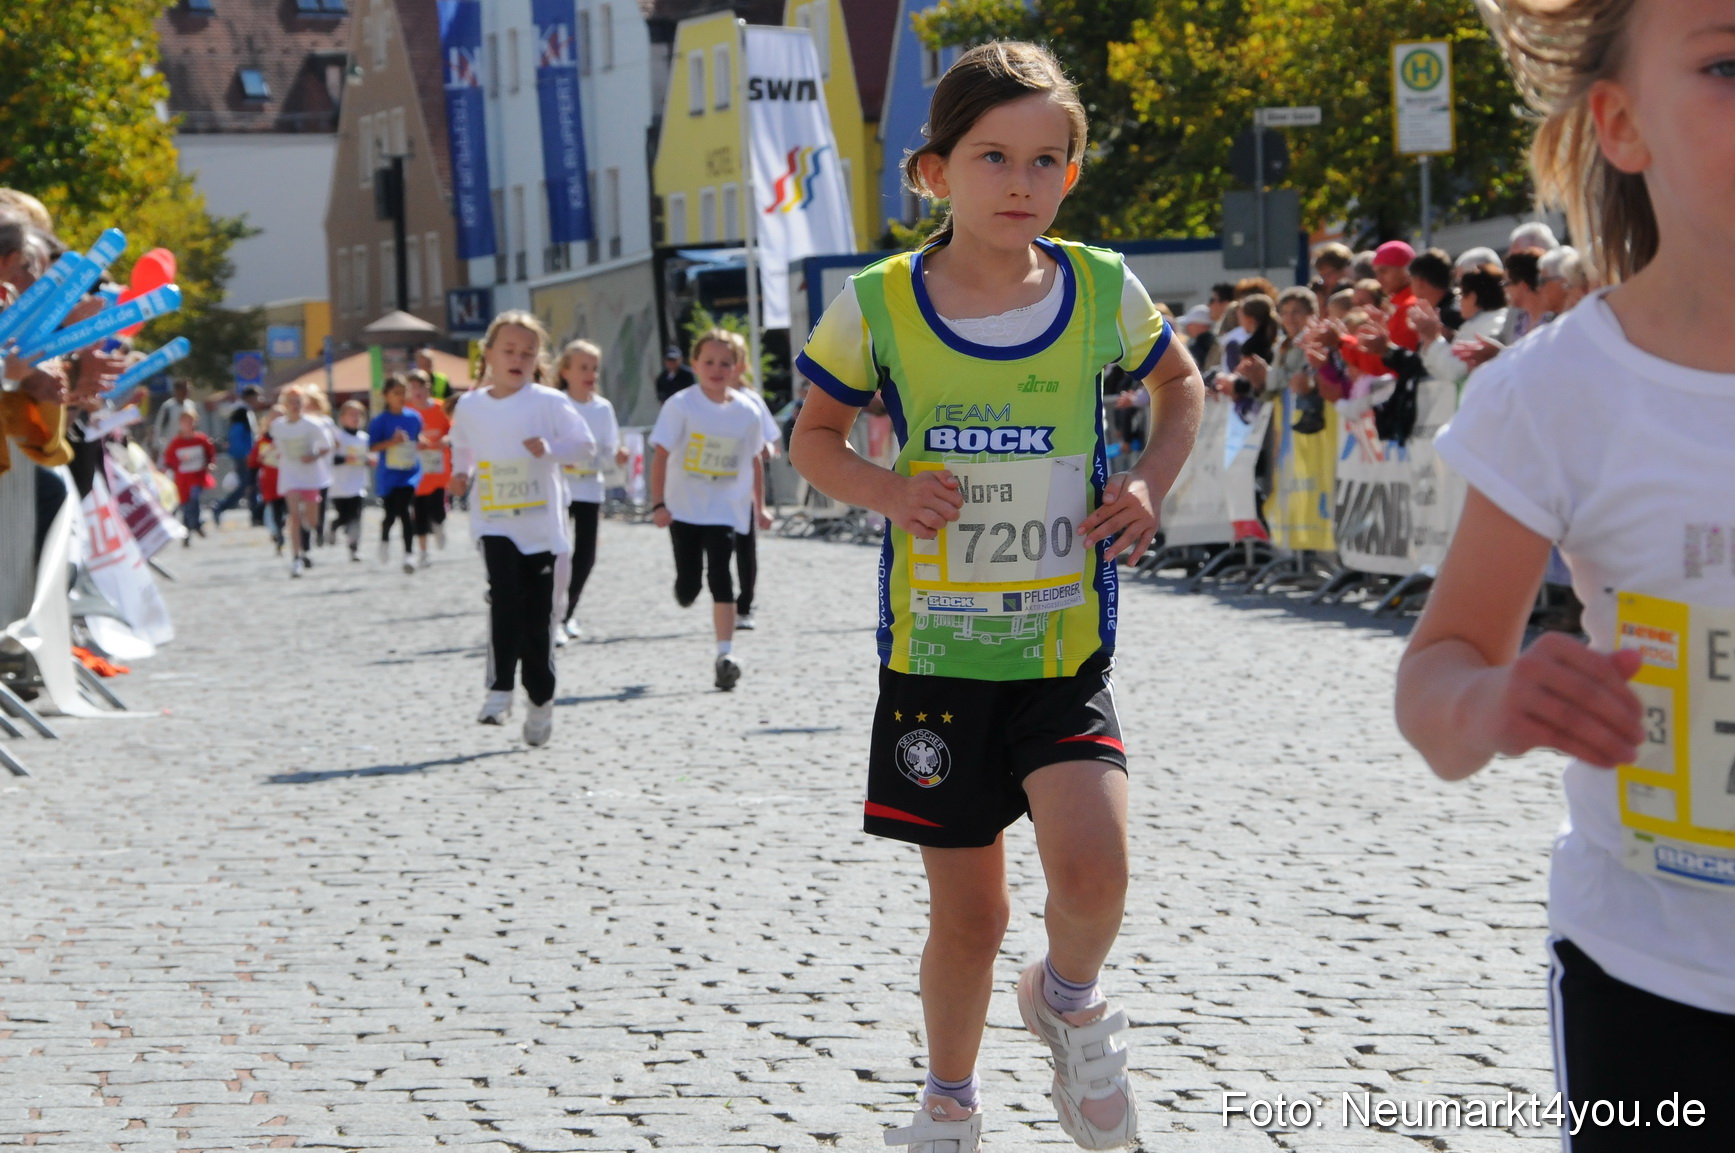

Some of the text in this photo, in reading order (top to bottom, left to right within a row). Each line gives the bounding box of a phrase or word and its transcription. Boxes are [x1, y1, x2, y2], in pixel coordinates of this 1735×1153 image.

[1411, 60, 1431, 81] H
[748, 78, 817, 101] swn
[935, 403, 1011, 422] TEAM
[924, 425, 1056, 454] BOCK
[495, 480, 540, 498] 7201
[953, 475, 1013, 503] Nora
[958, 516, 1073, 563] 7200
[928, 596, 974, 607] BOCK
[1024, 583, 1080, 603] PFLEIDERER
[899, 730, 944, 751] DEUTSCHER
